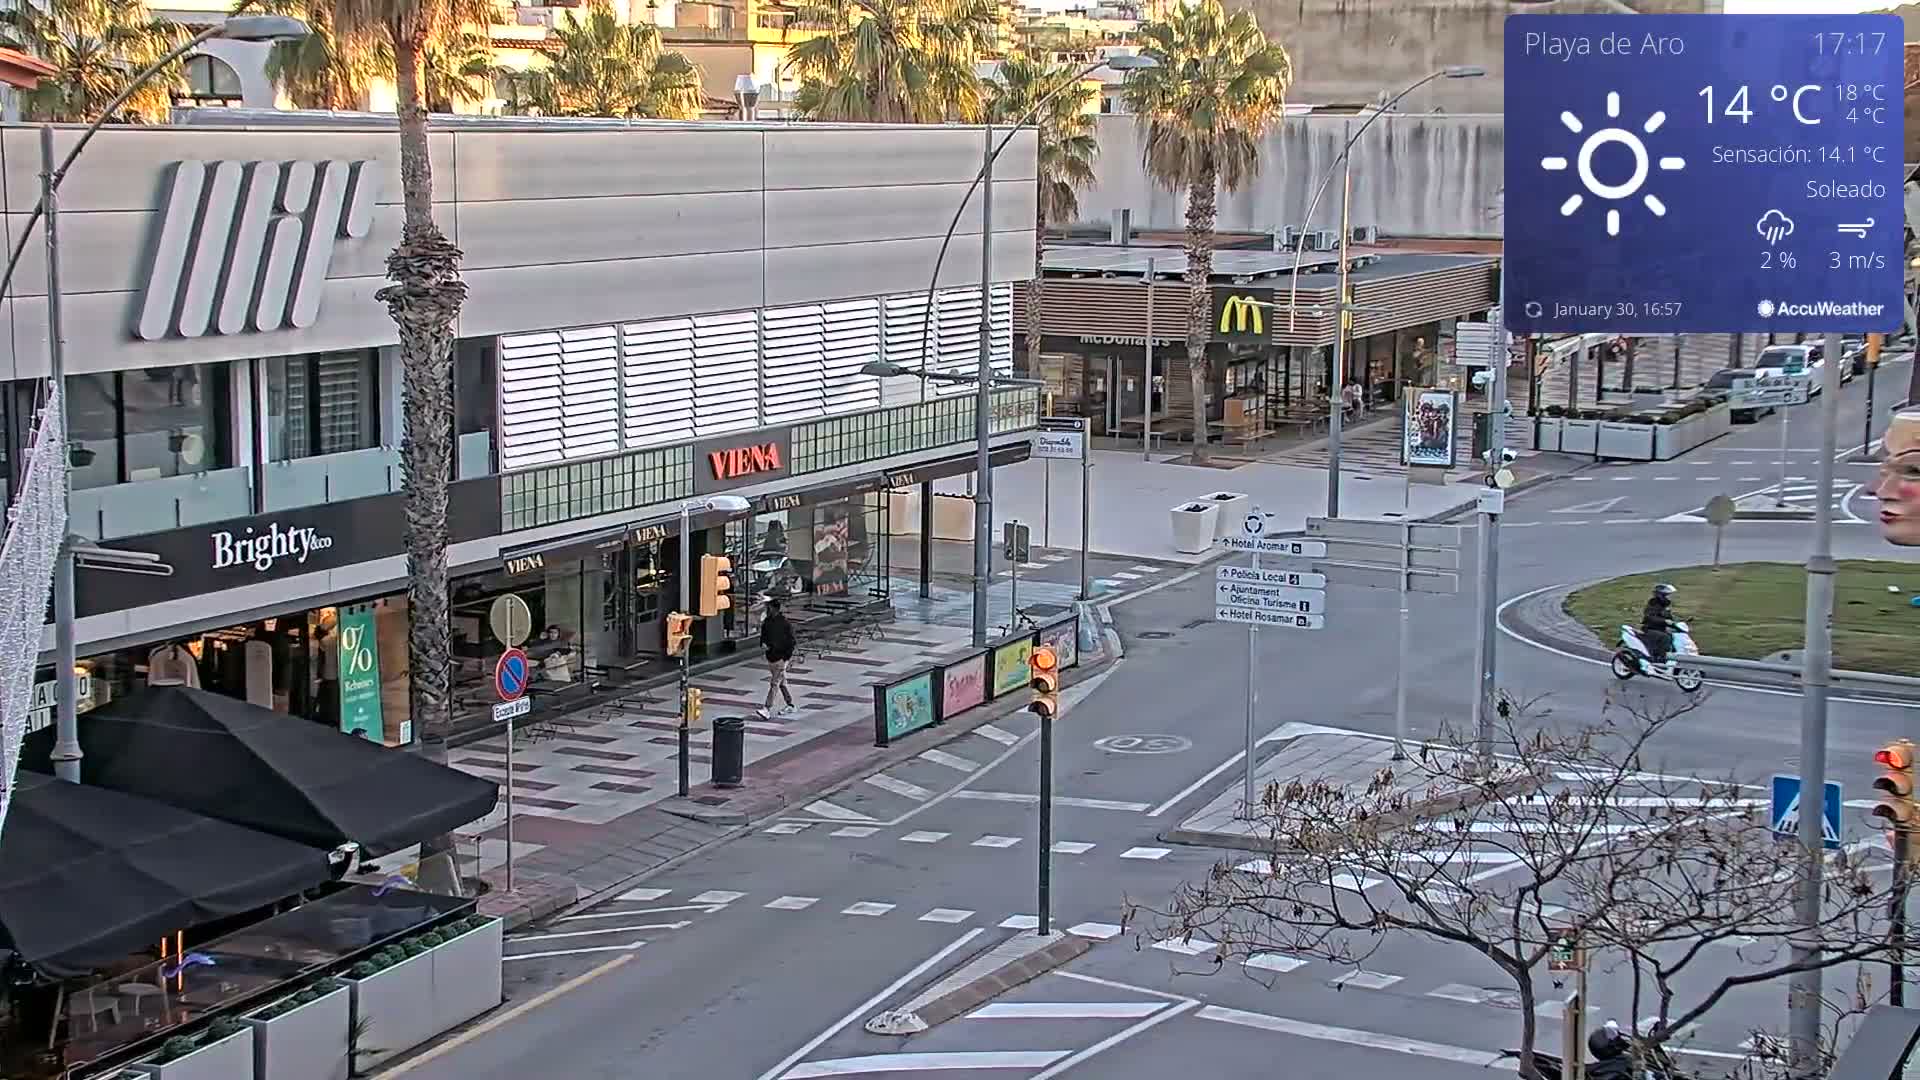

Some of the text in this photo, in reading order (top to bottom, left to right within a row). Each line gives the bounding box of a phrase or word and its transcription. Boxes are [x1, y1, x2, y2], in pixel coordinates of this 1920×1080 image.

[709, 442, 784, 480] VIENA
[635, 524, 667, 543] VIENA
[1231, 538, 1288, 551] Hotel Aromar
[506, 553, 545, 575] VIENA
[1230, 568, 1286, 582] Policia Local
[1229, 583, 1280, 597] Ajuntament
[1230, 594, 1297, 609] Oficina Turisme
[1230, 609, 1293, 624] Hotel Rosamar
